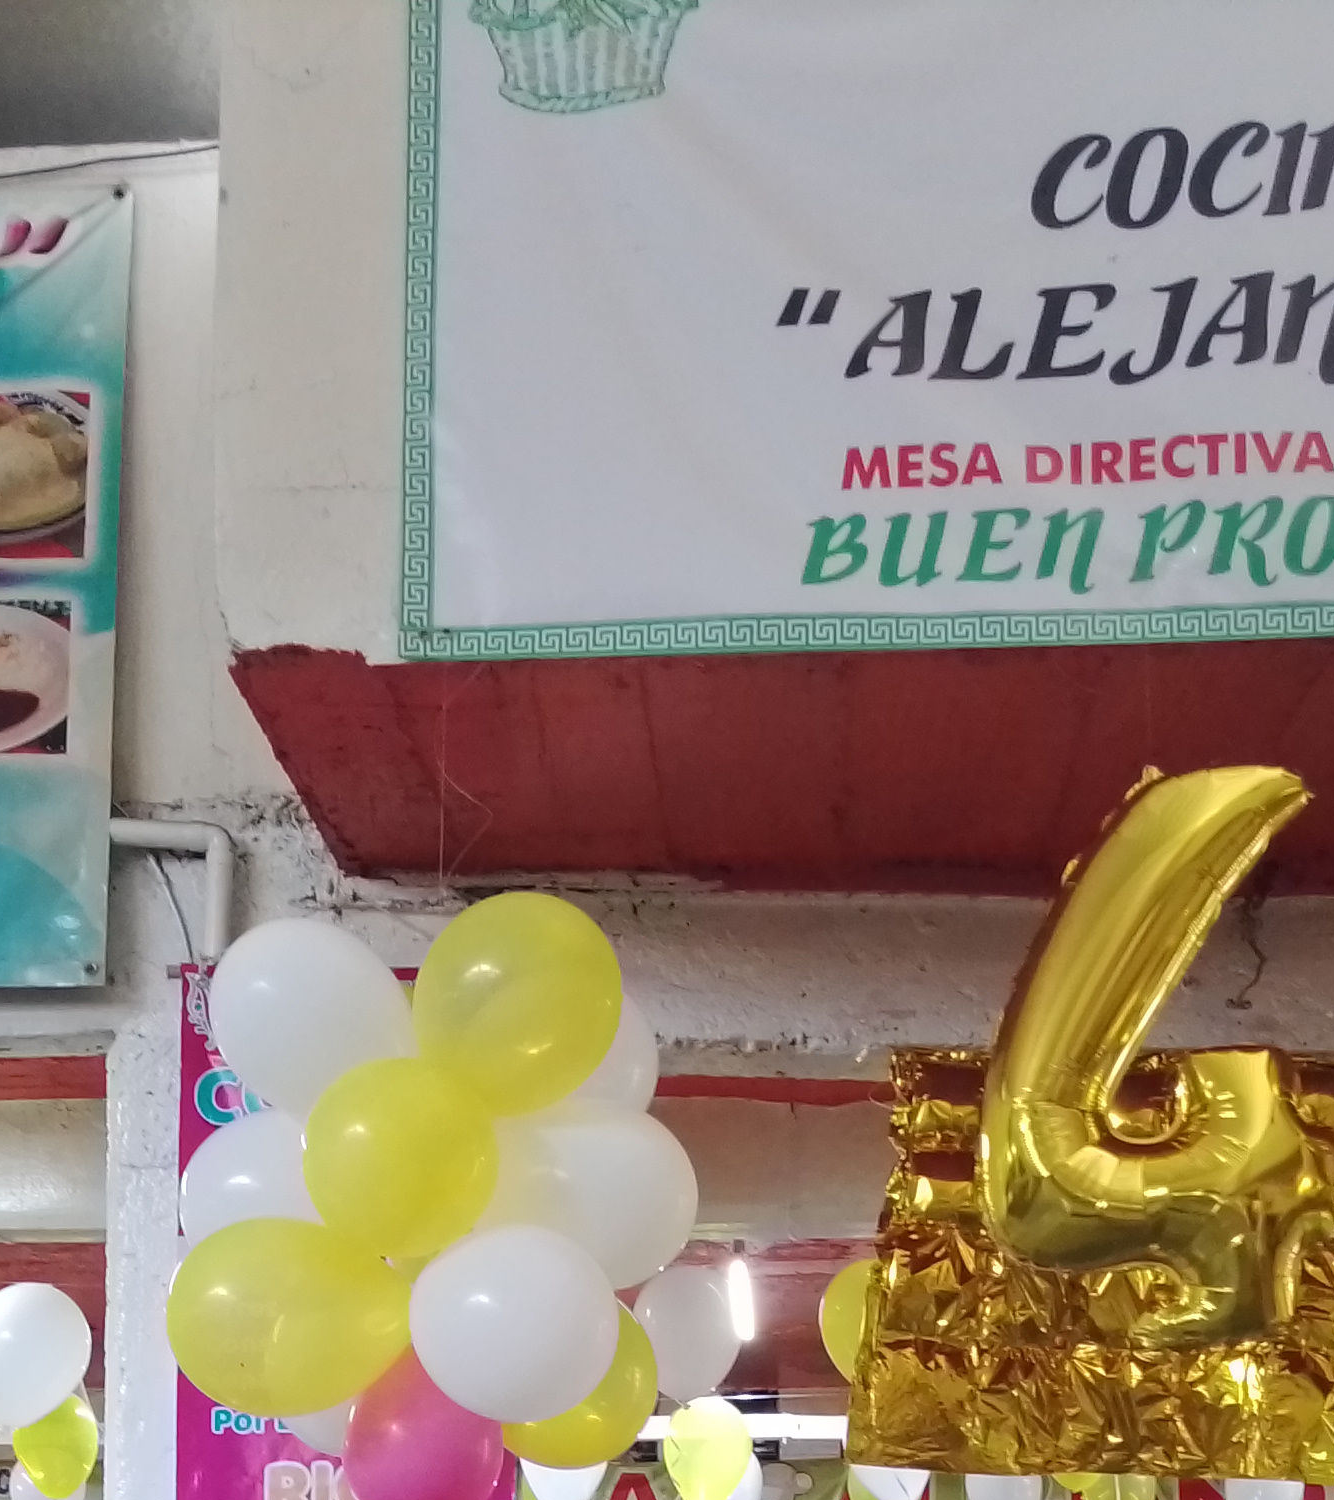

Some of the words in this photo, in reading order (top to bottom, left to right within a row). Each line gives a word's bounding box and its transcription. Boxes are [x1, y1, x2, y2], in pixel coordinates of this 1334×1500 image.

[841, 443, 1003, 491] MESA
[1024, 432, 1334, 487] DIRECTIVA
[800, 507, 1105, 595] BUEN
